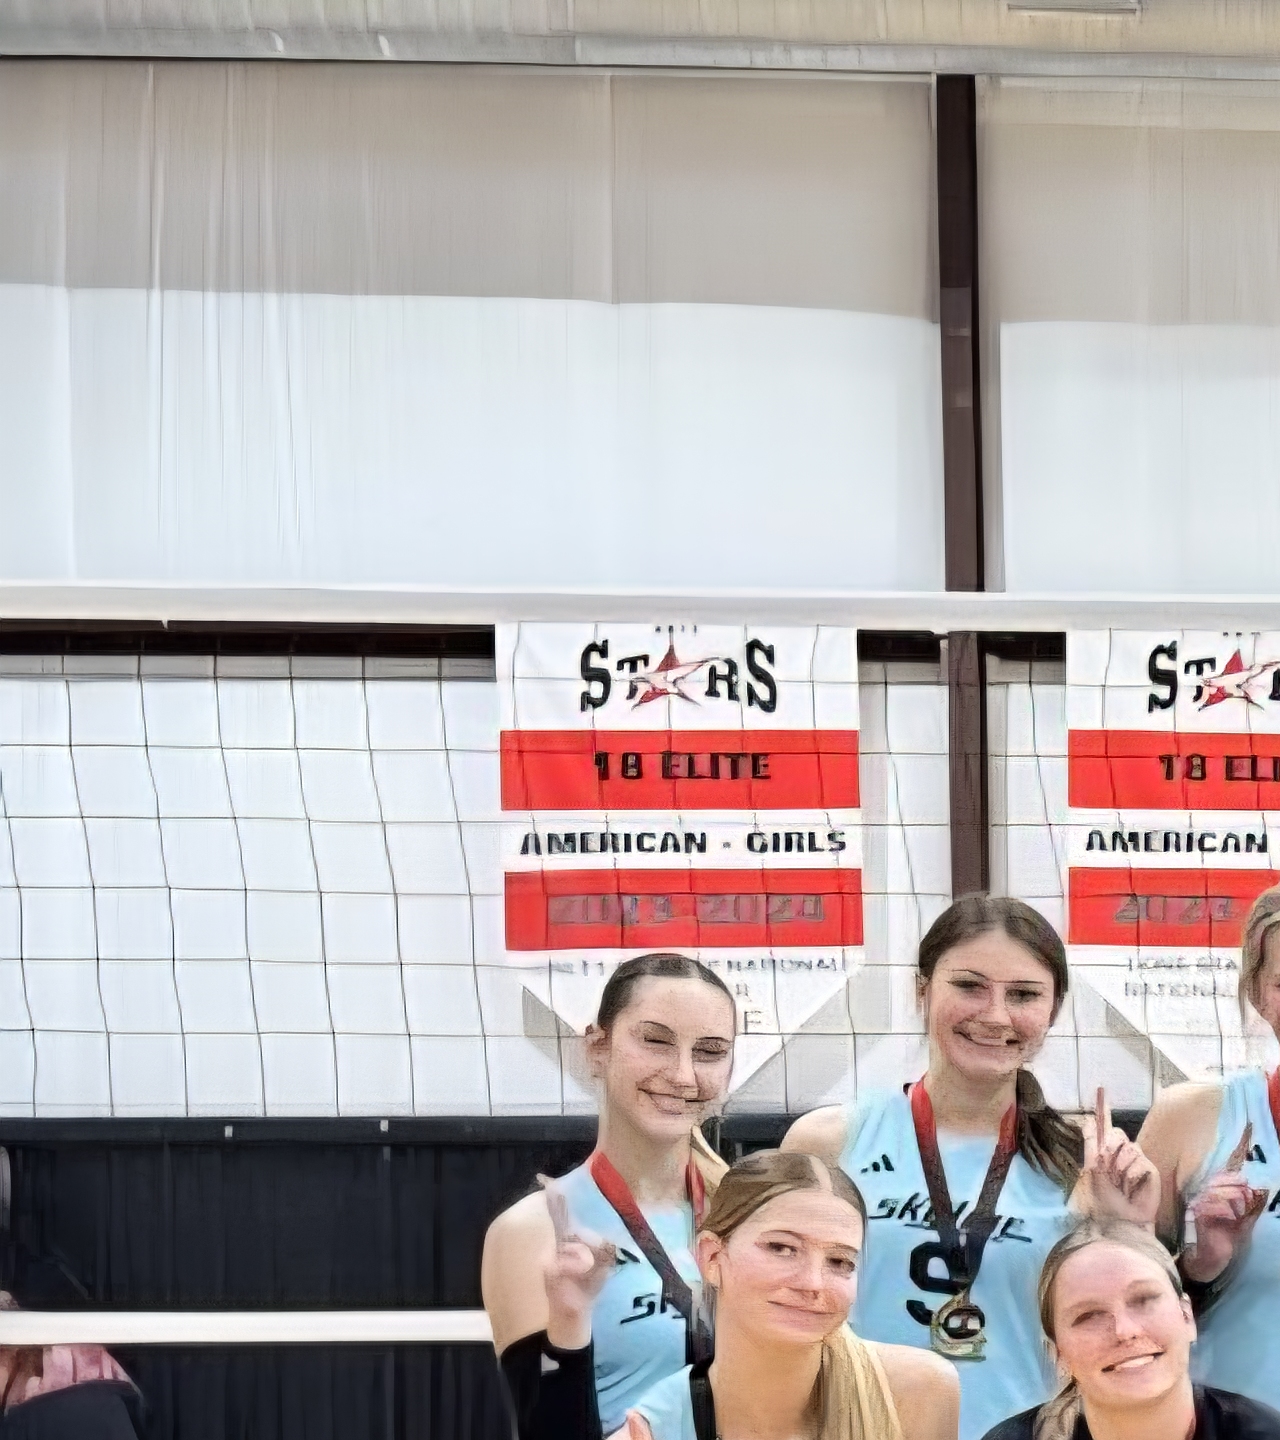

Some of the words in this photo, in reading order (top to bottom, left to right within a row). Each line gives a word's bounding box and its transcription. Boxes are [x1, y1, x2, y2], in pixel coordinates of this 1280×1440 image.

[580, 637, 777, 713] STARS
[594, 751, 642, 780] 18
[662, 751, 771, 780] ELITE
[1159, 753, 1207, 781] 18
[520, 831, 707, 855] AMERICAN
[746, 831, 846, 854] GIRLS
[1086, 830, 1268, 854] AMERICAN
